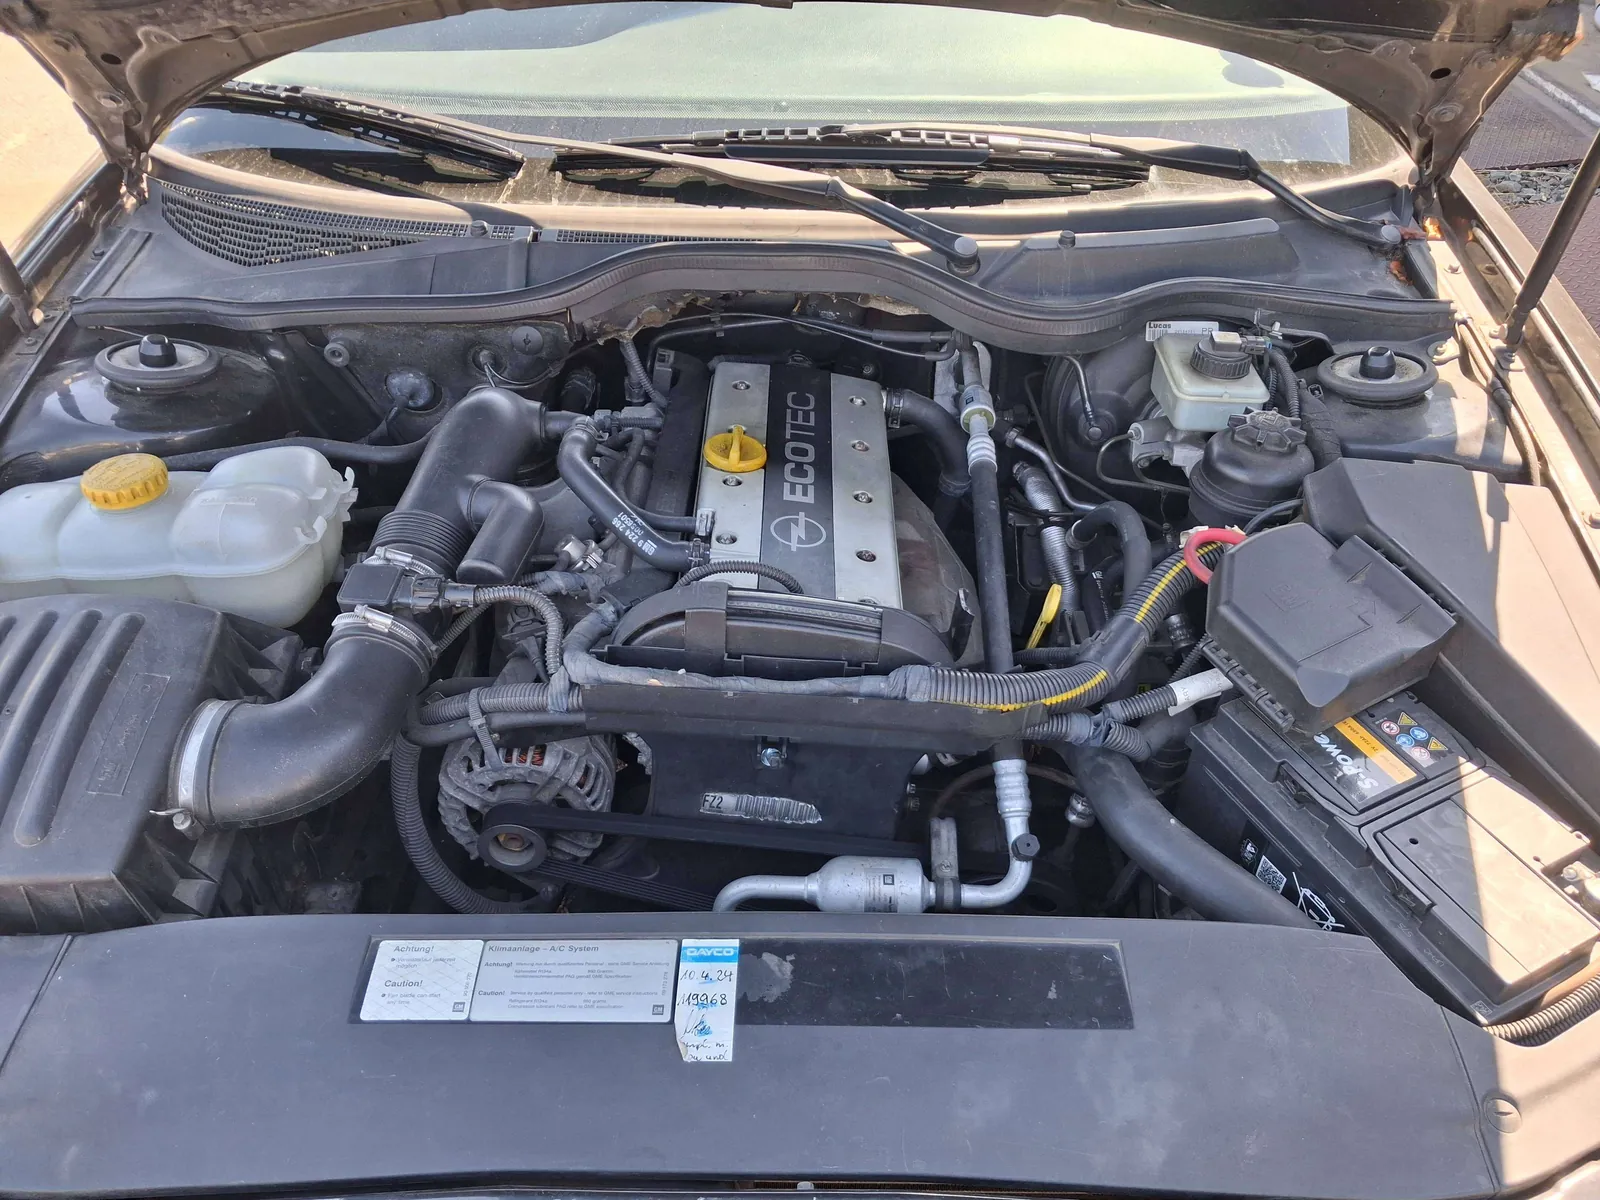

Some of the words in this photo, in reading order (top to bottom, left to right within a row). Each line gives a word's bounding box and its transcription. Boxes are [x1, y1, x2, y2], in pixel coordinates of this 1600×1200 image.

[783, 391, 815, 504] ECOTEC
[702, 794, 724, 810] FZ2
[394, 945, 435, 954] Achtung!
[488, 945, 541, 954] Klimaanlage
[568, 945, 599, 953] System
[686, 948, 735, 956] DAYCO
[384, 980, 423, 988] Caution!
